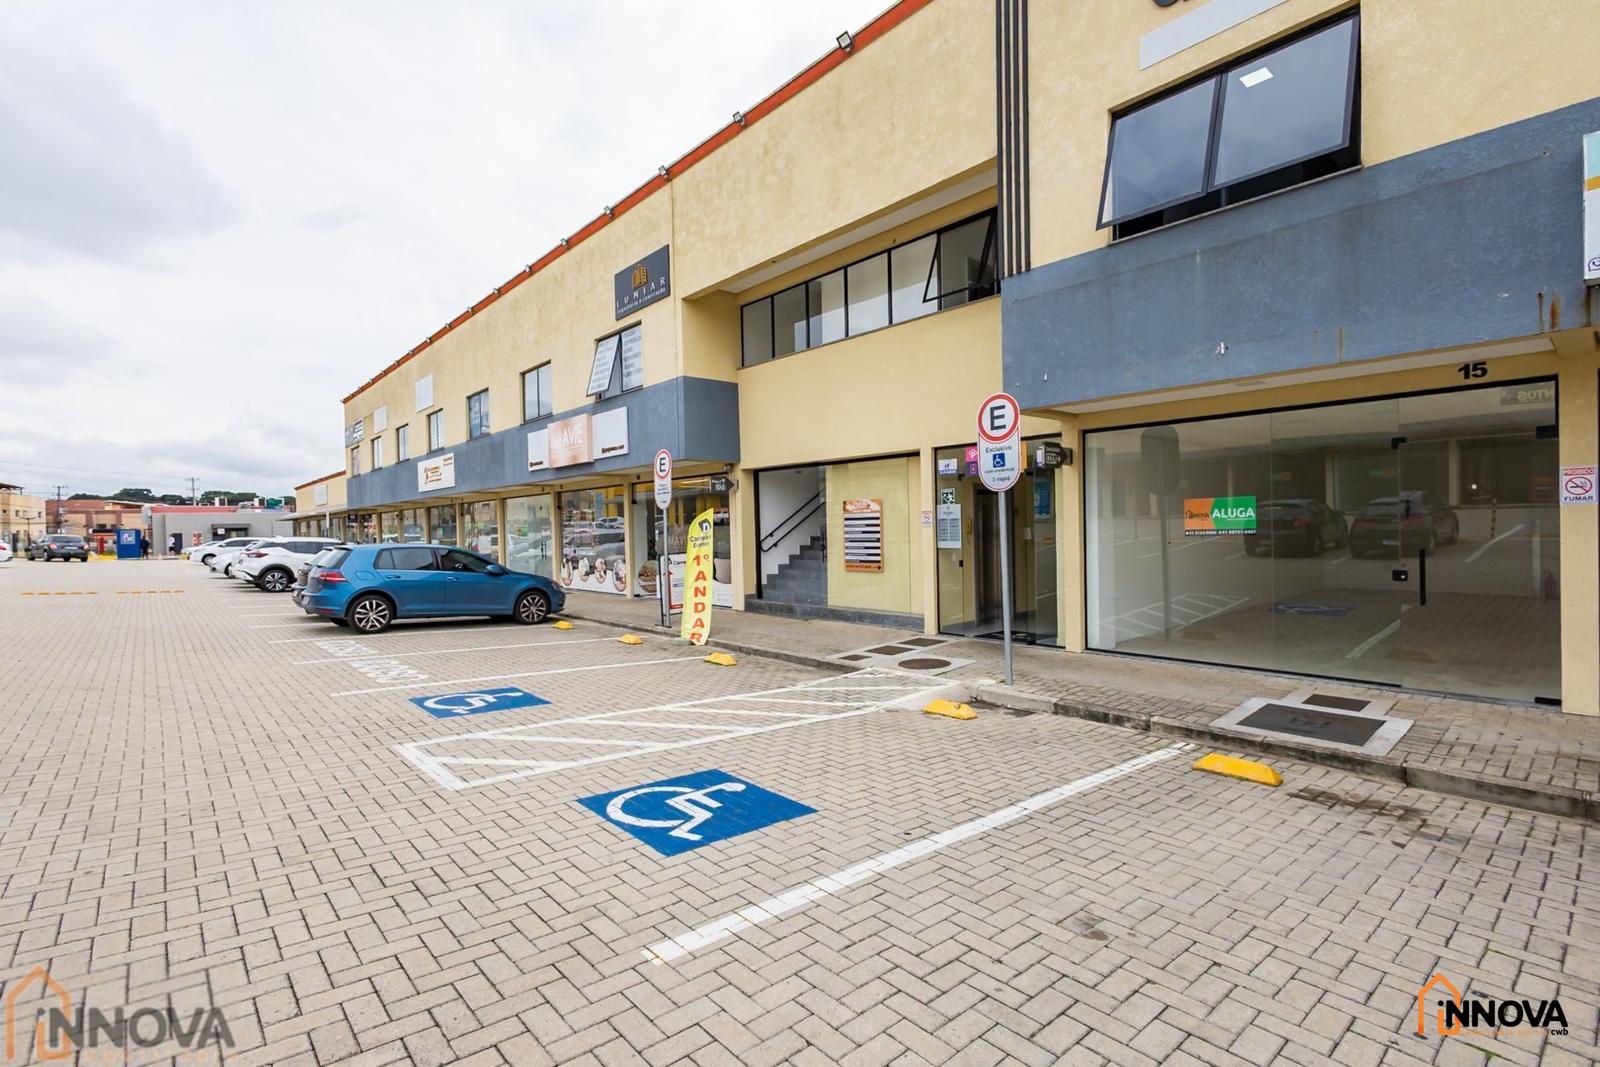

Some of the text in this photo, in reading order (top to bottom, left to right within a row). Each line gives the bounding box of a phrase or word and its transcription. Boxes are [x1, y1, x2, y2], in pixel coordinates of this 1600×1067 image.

[616, 276, 666, 308] LUMIAR
[1457, 361, 1488, 380] 15
[989, 404, 1007, 431] E
[985, 445, 1012, 454] Exclusivo
[659, 457, 667, 473] E
[1212, 507, 1256, 519] ALUGA
[692, 553, 711, 567] 1º
[690, 570, 707, 643] ANDAR
